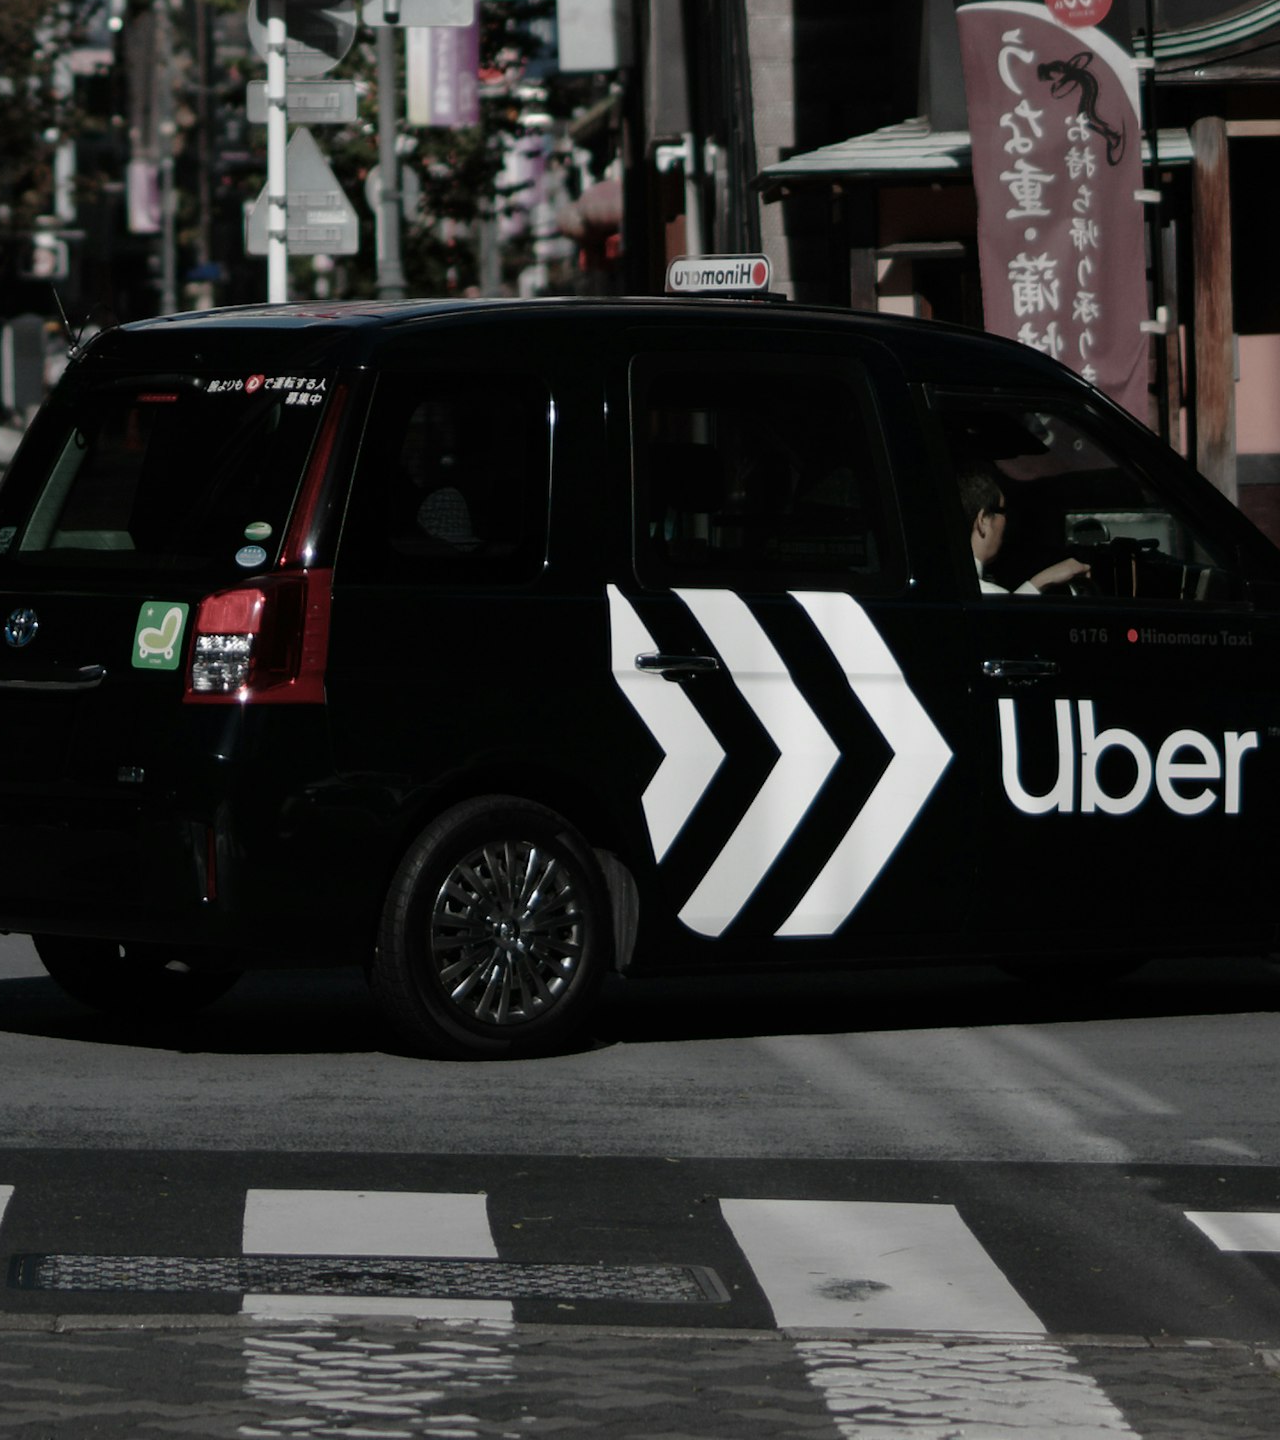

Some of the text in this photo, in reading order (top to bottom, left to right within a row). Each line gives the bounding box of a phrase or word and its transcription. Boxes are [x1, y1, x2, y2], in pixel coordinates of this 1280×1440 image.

[1069, 628, 1254, 647] 6176 Hinomaru Taxi
[997, 697, 1260, 816] Uber
